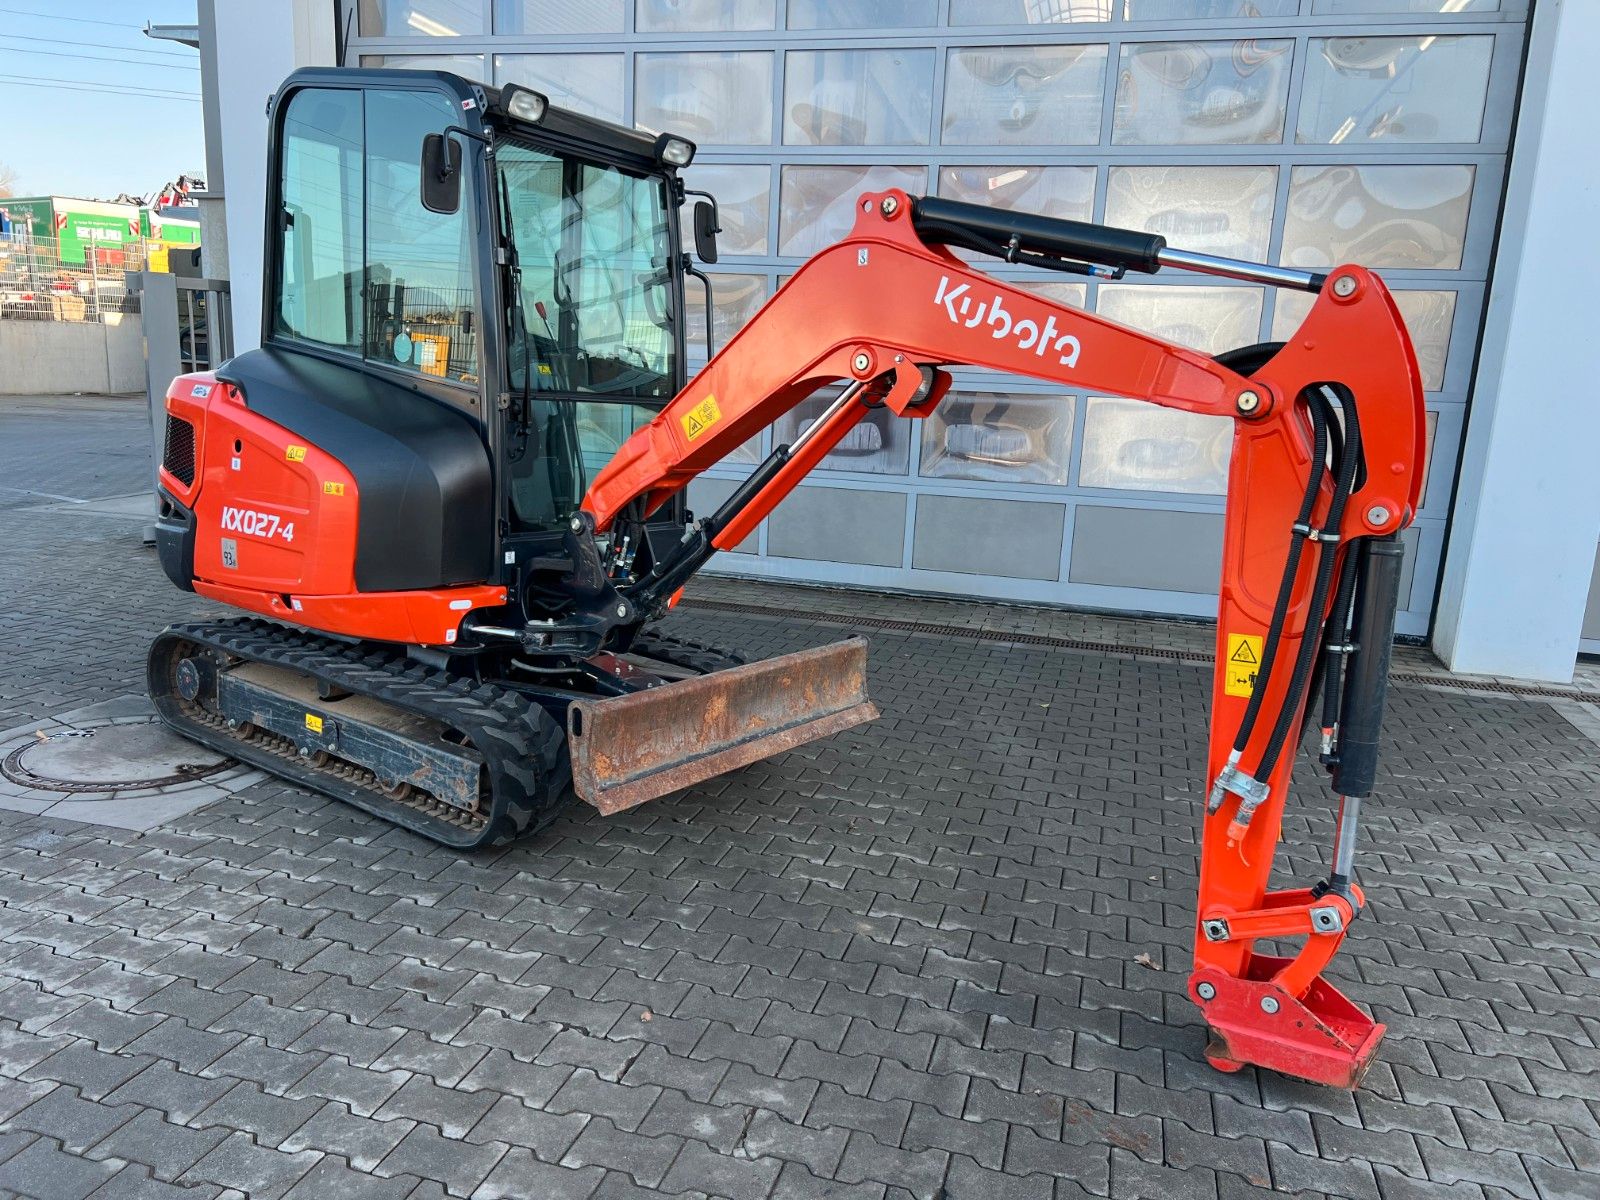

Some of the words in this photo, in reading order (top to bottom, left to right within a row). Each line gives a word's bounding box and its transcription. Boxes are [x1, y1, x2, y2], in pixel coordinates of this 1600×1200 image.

[934, 275, 1081, 369] Kubota
[221, 506, 294, 543] KX027-4
[223, 551, 233, 566] 93
